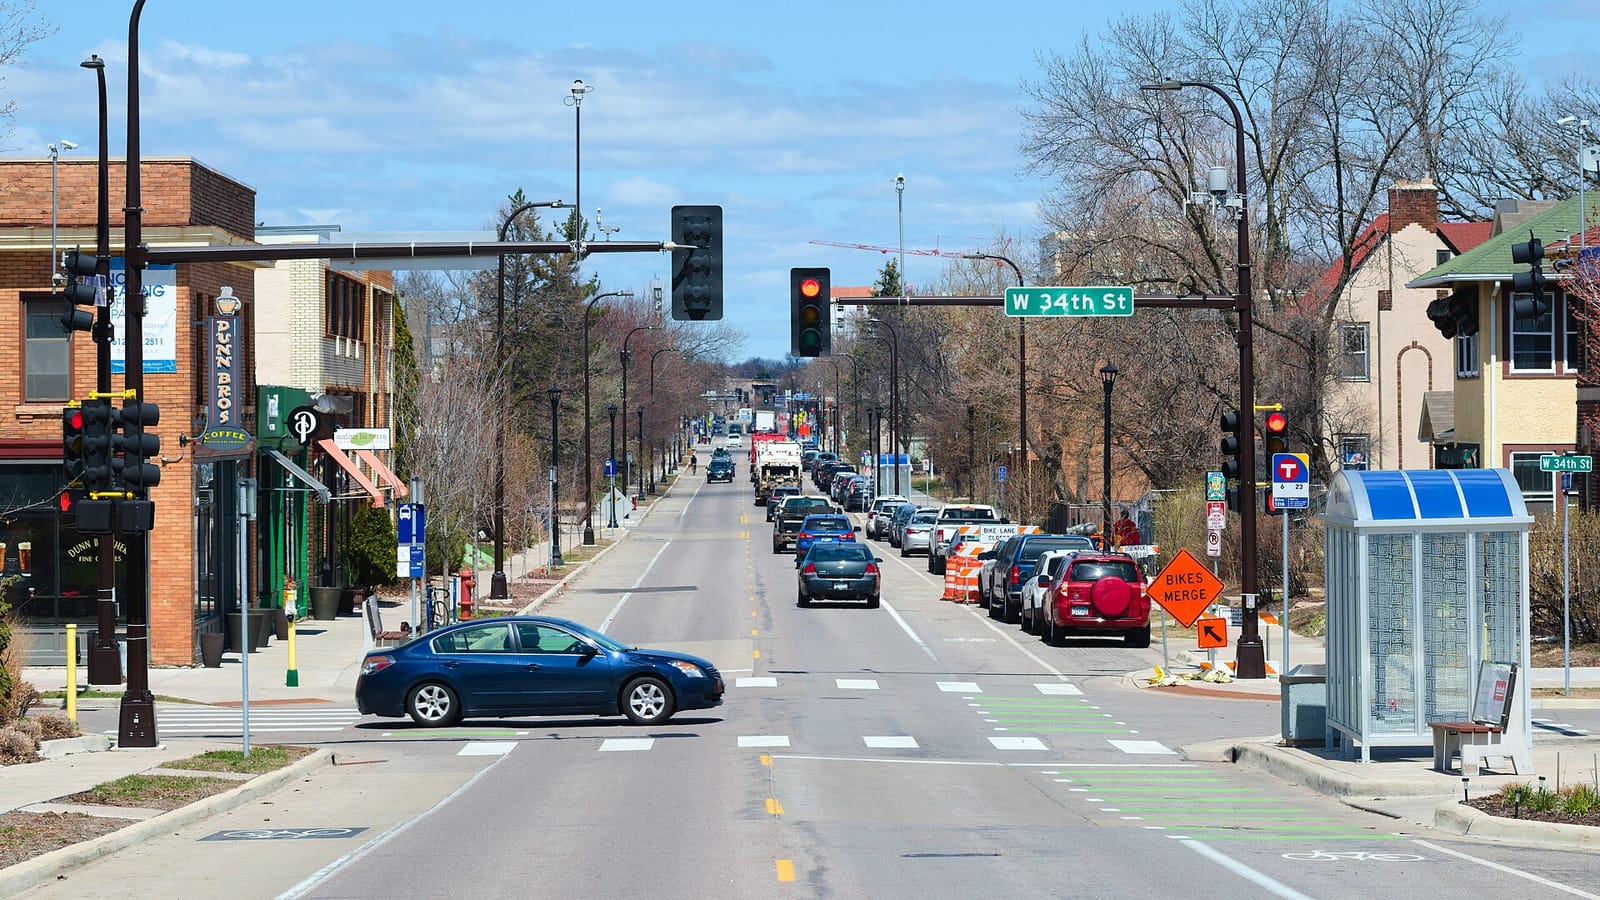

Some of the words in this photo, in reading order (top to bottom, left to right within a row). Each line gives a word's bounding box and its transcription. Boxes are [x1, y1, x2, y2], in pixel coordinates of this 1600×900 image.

[1013, 294, 1029, 310] W
[1040, 293, 1095, 310] 34th
[1103, 293, 1126, 310] St
[215, 320, 232, 368] DUNN
[216, 372, 232, 424] BROS
[204, 431, 246, 441] COFFEE
[1280, 463, 1297, 478] T
[1542, 458, 1551, 468] W
[1553, 458, 1577, 469] 34th
[1580, 459, 1590, 469] St
[67, 540, 91, 558] DUNN
[1166, 573, 1203, 586] BIKES
[1164, 589, 1207, 602] MERGE
